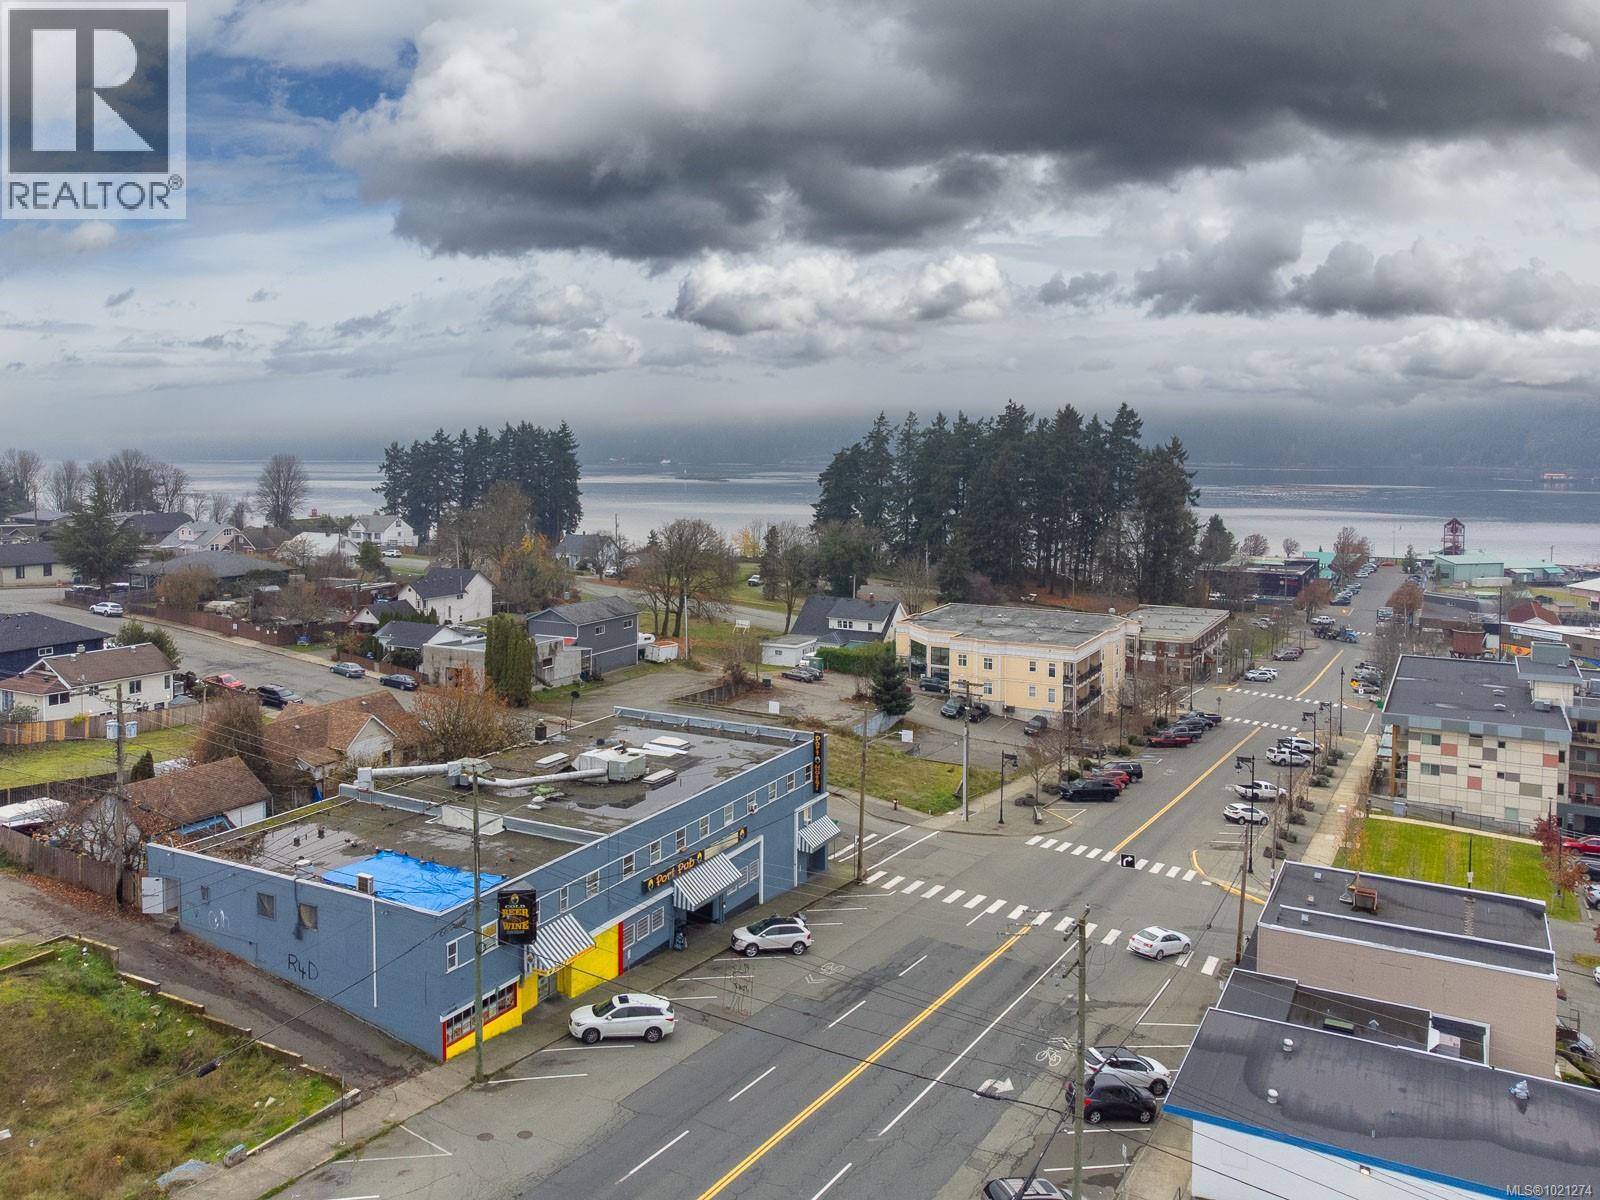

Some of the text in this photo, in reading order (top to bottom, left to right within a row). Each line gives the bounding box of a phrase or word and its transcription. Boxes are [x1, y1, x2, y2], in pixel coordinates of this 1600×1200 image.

[656, 858, 695, 887] Port Pub
[501, 908, 529, 917] BEER
[503, 920, 529, 930] WINE
